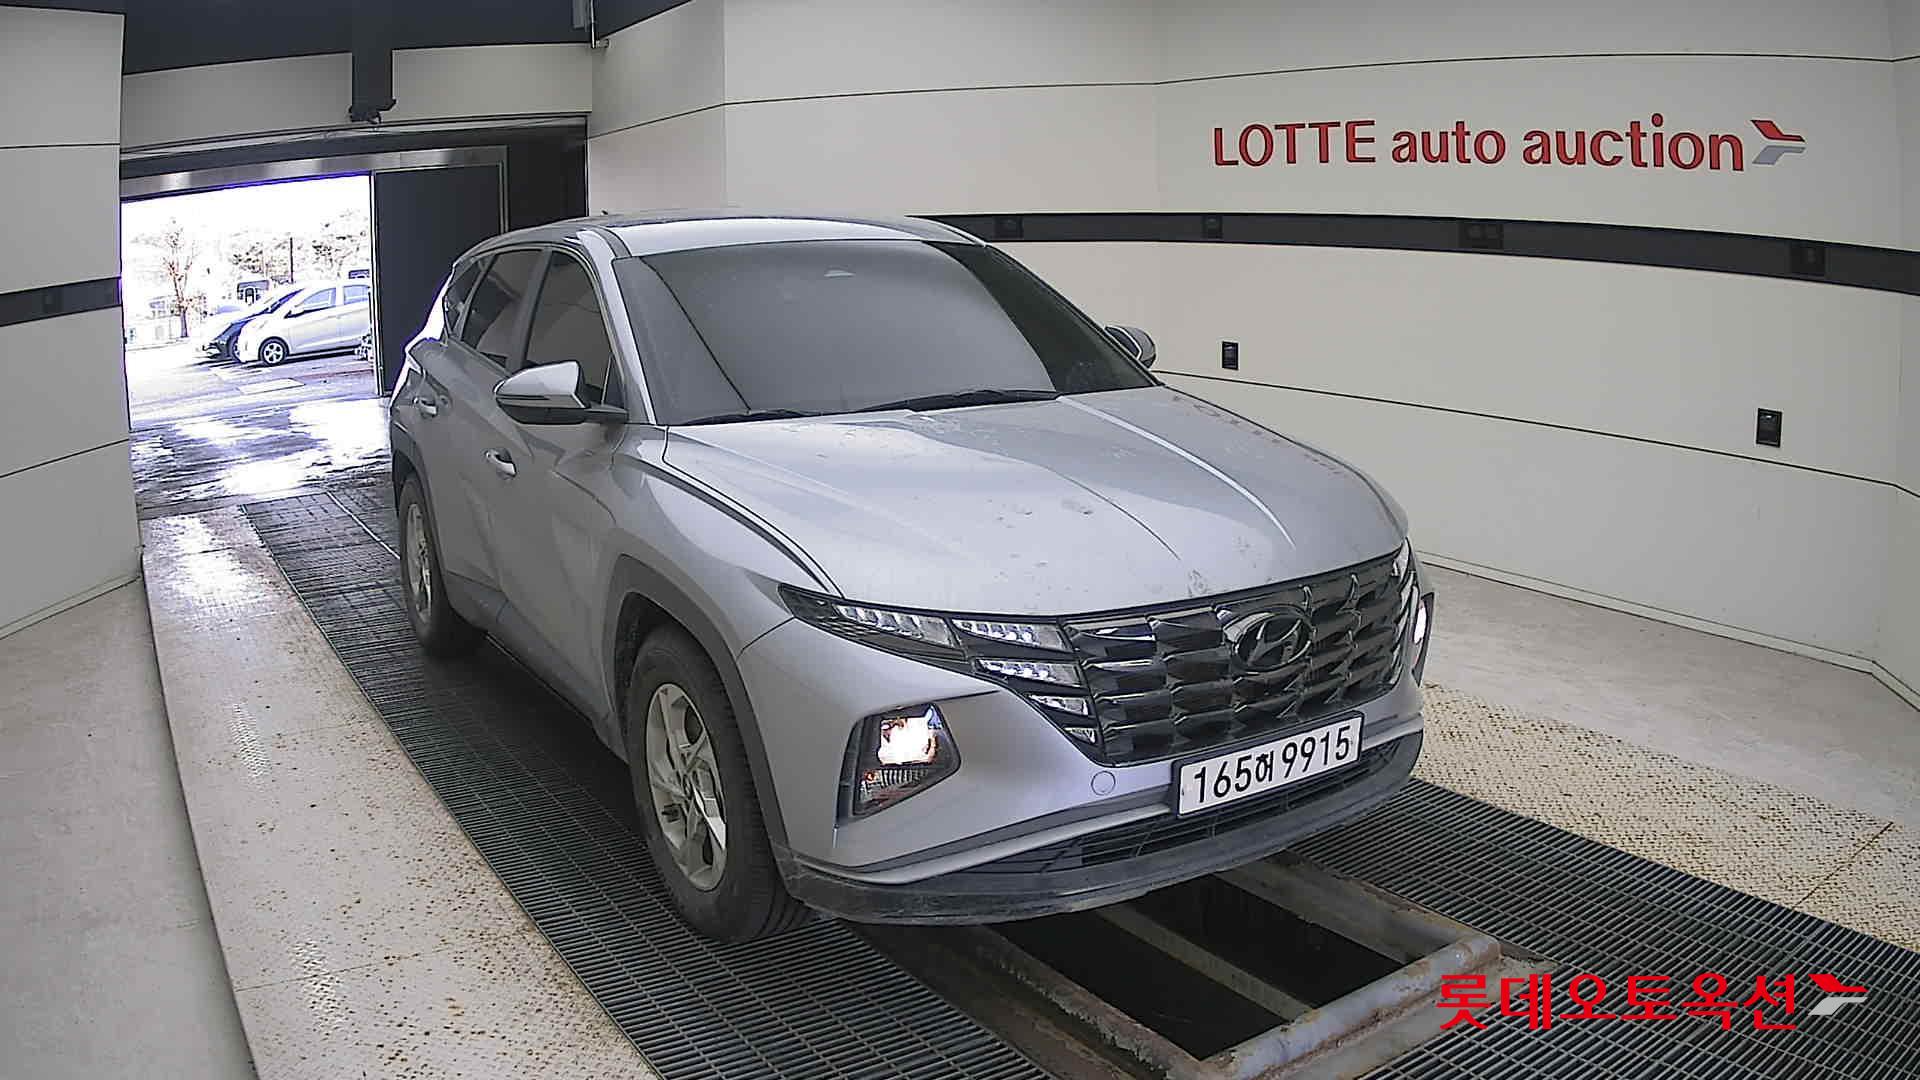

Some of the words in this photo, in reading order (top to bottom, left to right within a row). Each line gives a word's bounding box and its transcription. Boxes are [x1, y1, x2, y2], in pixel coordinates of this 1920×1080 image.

[1212, 119, 1377, 168] LOTTE
[1391, 120, 1507, 164] auto
[1522, 113, 1745, 172] auction
[1281, 725, 1351, 779] 9915
